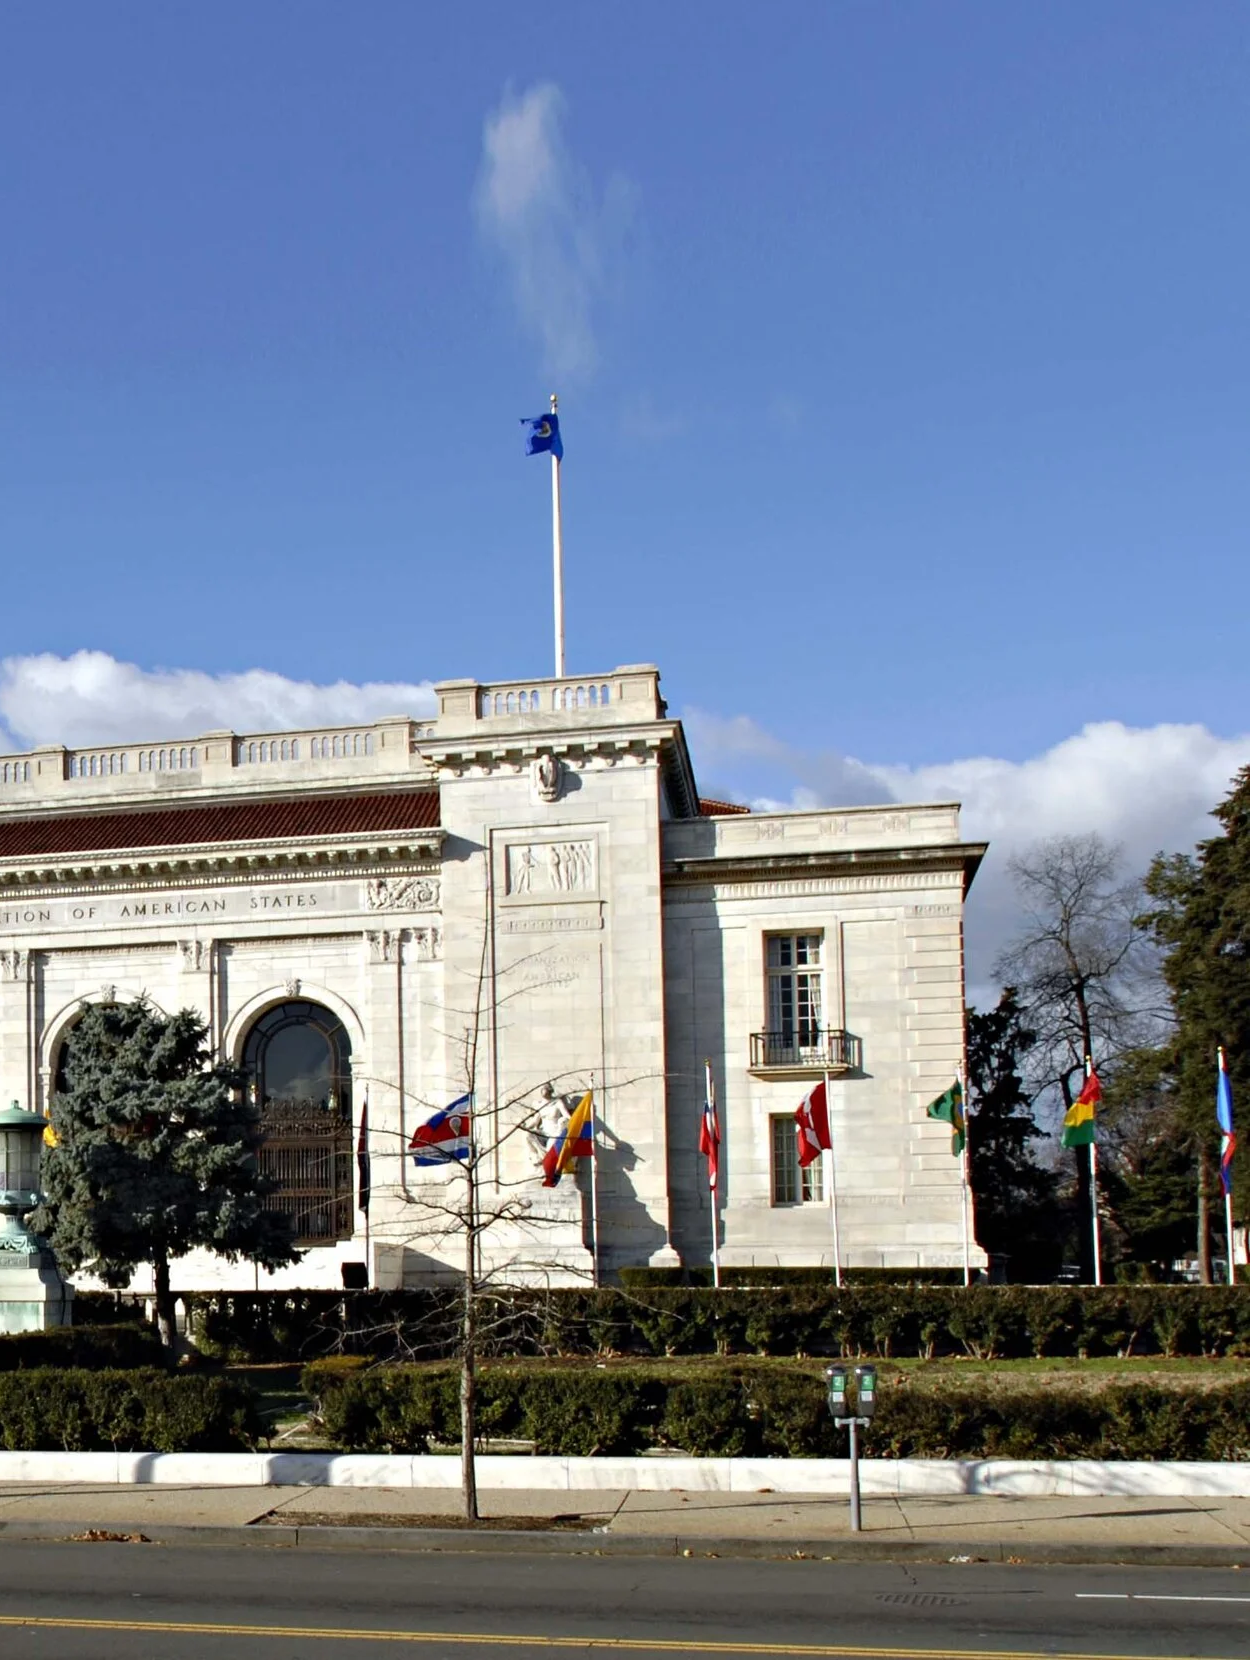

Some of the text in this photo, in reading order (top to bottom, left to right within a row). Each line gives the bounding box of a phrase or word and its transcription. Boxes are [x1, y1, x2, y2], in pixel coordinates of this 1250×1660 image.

[72, 907, 97, 921] OF
[120, 899, 226, 917] AMERICAN
[250, 894, 318, 909] STATES
